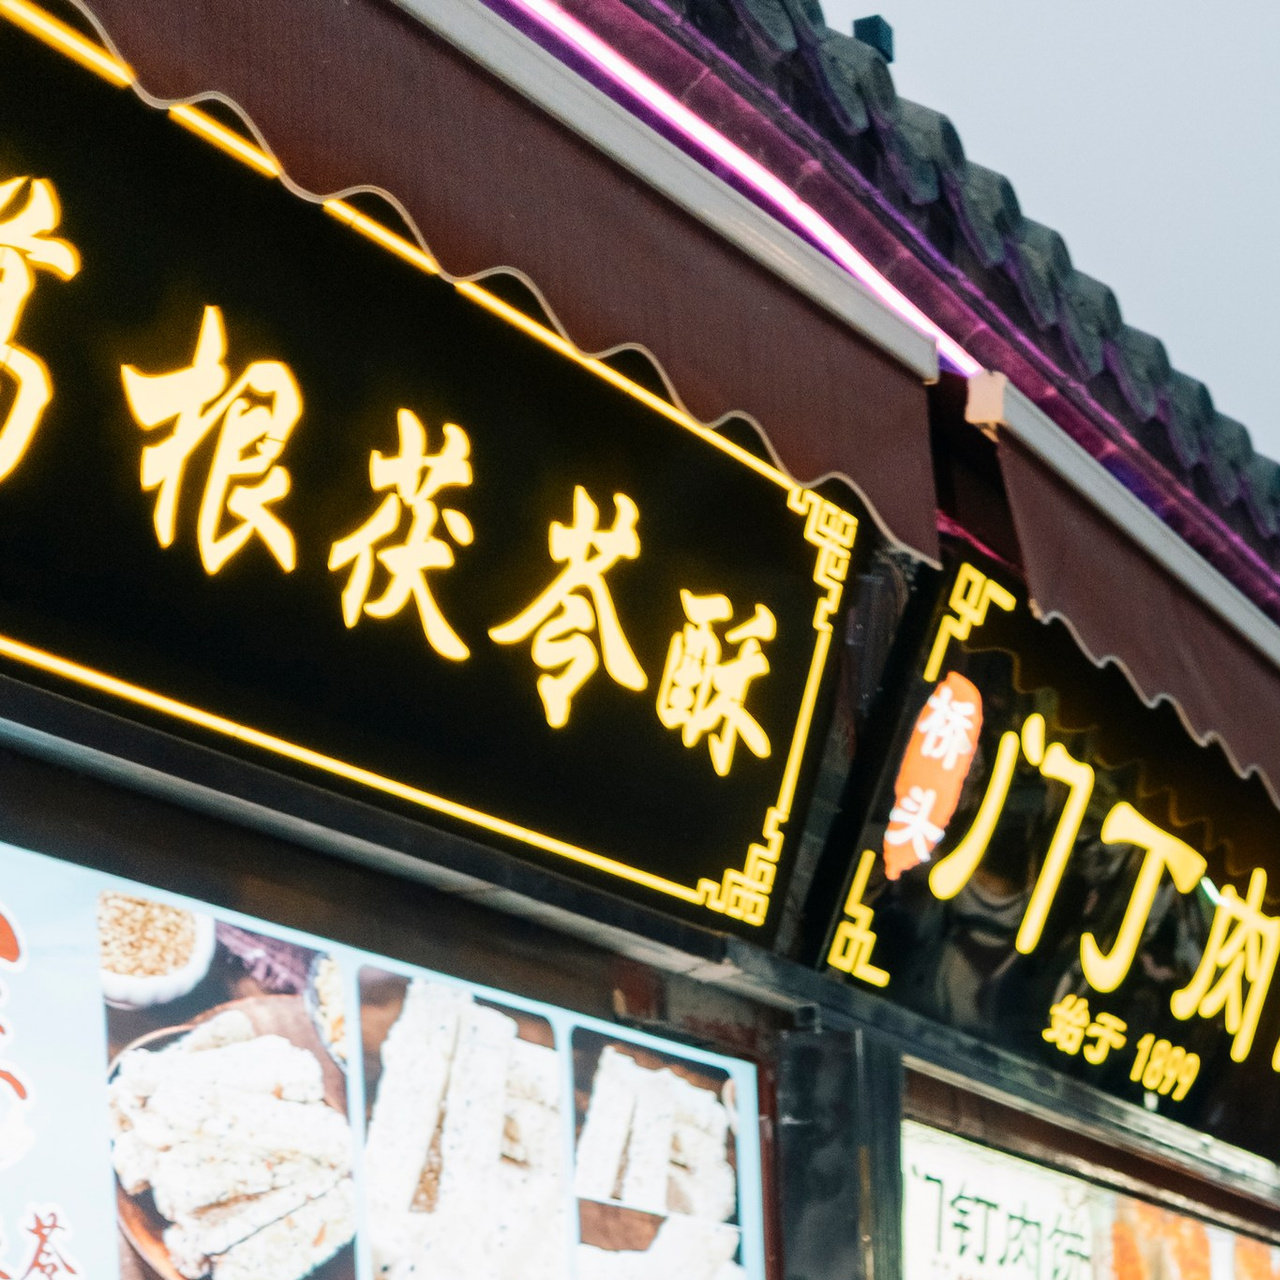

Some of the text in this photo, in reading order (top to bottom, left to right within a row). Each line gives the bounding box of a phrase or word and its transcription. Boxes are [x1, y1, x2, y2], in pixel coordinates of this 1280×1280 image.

[884, 686, 975, 862] 桥头
[1042, 993, 1201, 1101] 始于 1899
